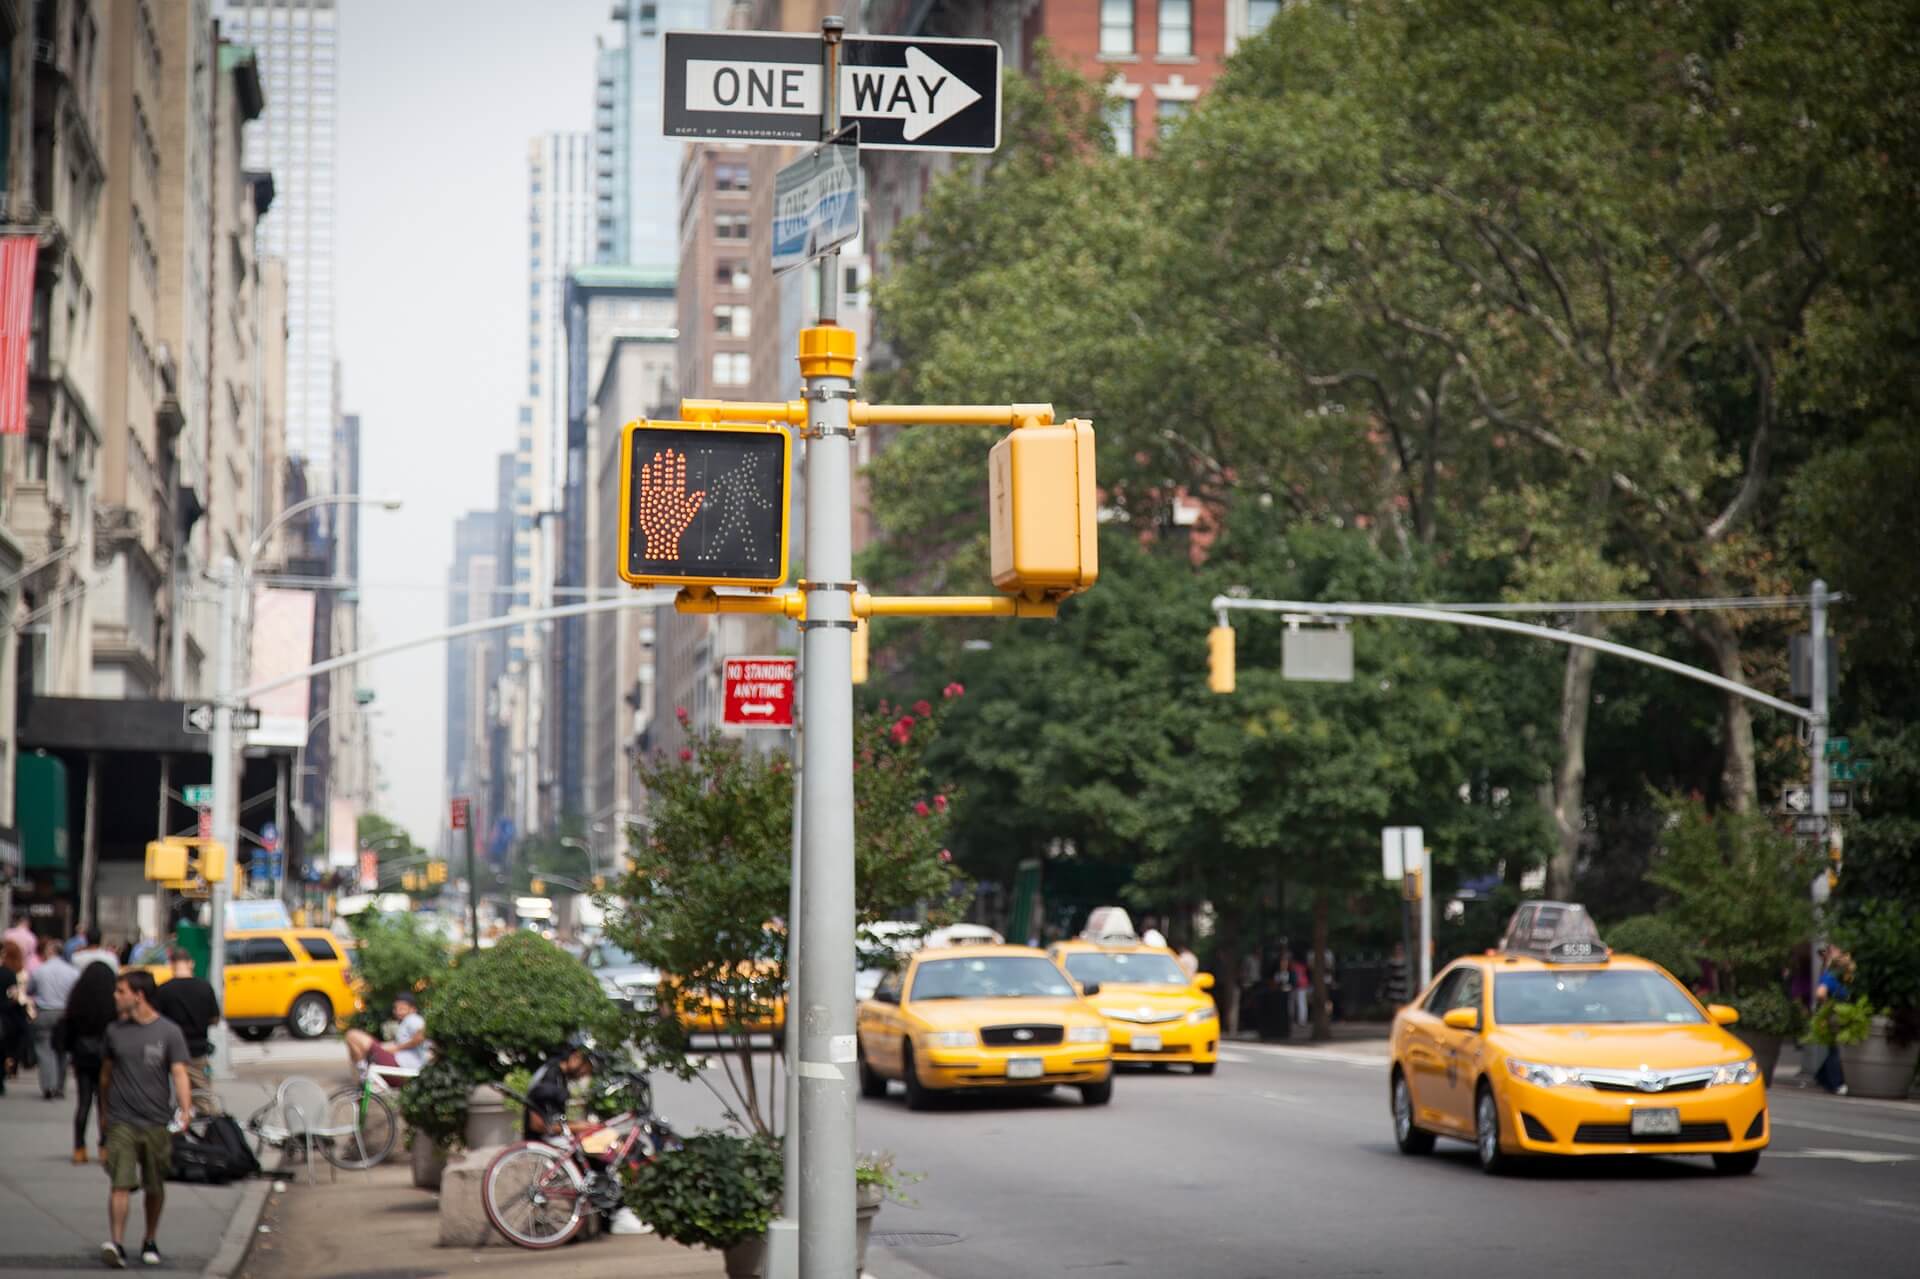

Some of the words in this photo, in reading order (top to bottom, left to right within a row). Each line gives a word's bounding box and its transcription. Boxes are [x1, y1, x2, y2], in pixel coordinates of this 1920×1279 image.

[713, 67, 804, 108] ONE
[852, 73, 946, 113] WAY
[726, 129, 802, 137] TRANSPORTATION
[784, 188, 809, 236] ONE
[819, 167, 845, 219] WAY
[727, 664, 742, 680] NO
[744, 664, 793, 680] STANDING
[733, 683, 784, 698] ANYTIME
